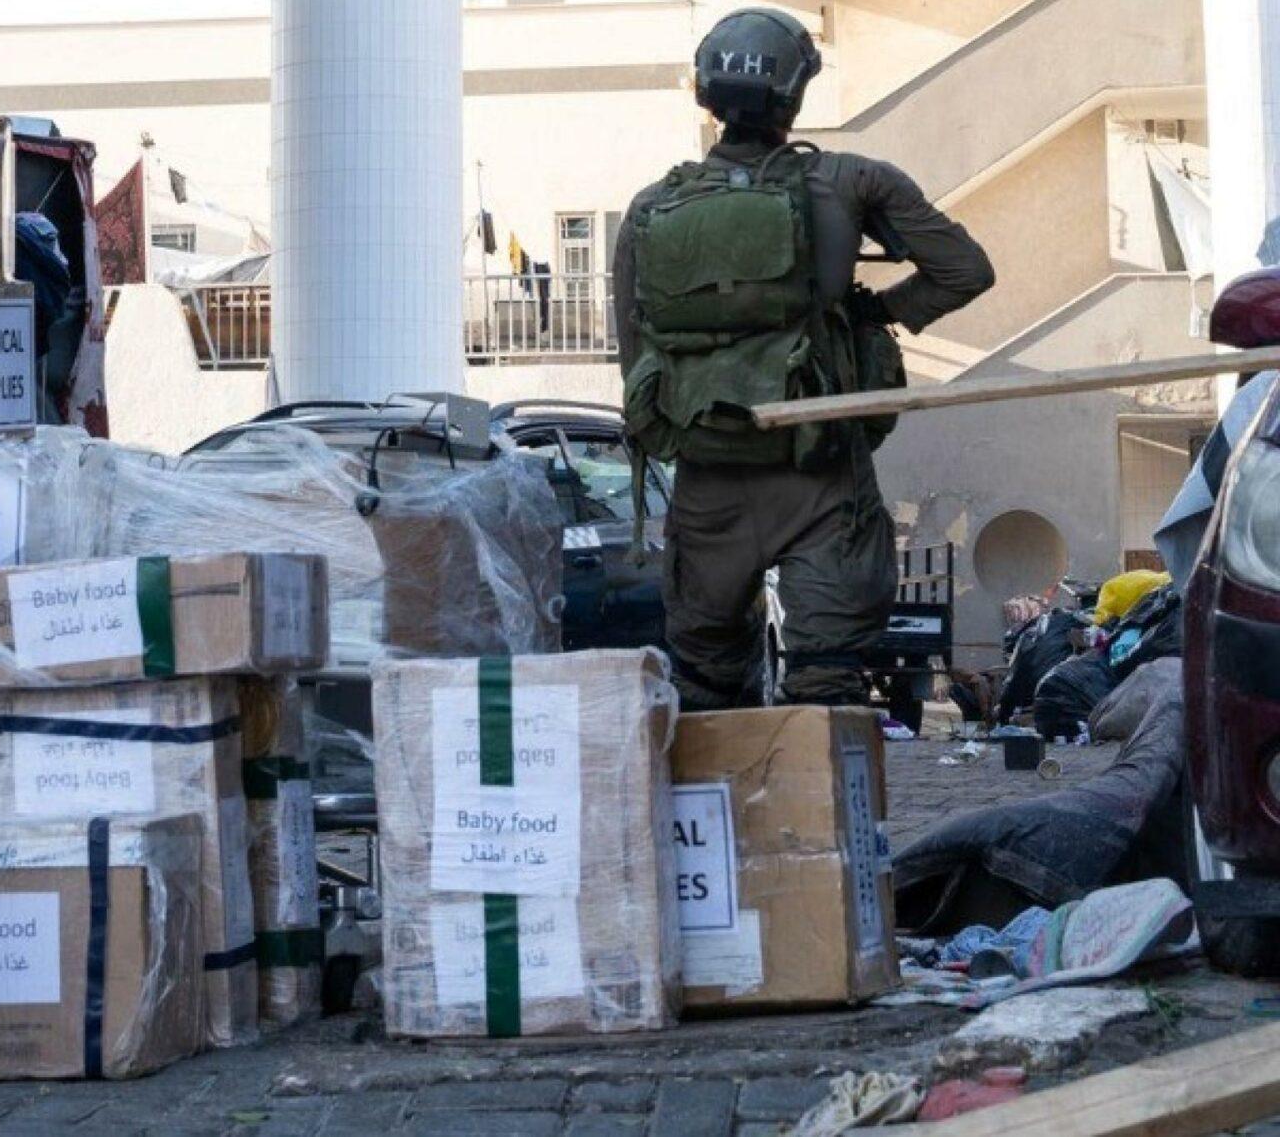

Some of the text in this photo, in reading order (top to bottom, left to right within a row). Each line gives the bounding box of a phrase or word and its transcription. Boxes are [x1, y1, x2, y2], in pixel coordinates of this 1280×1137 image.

[722, 50, 771, 76] Y.H.
[32, 577, 127, 609] Baby food
[515, 747, 556, 768] Bab
[457, 810, 558, 835] Baby food
